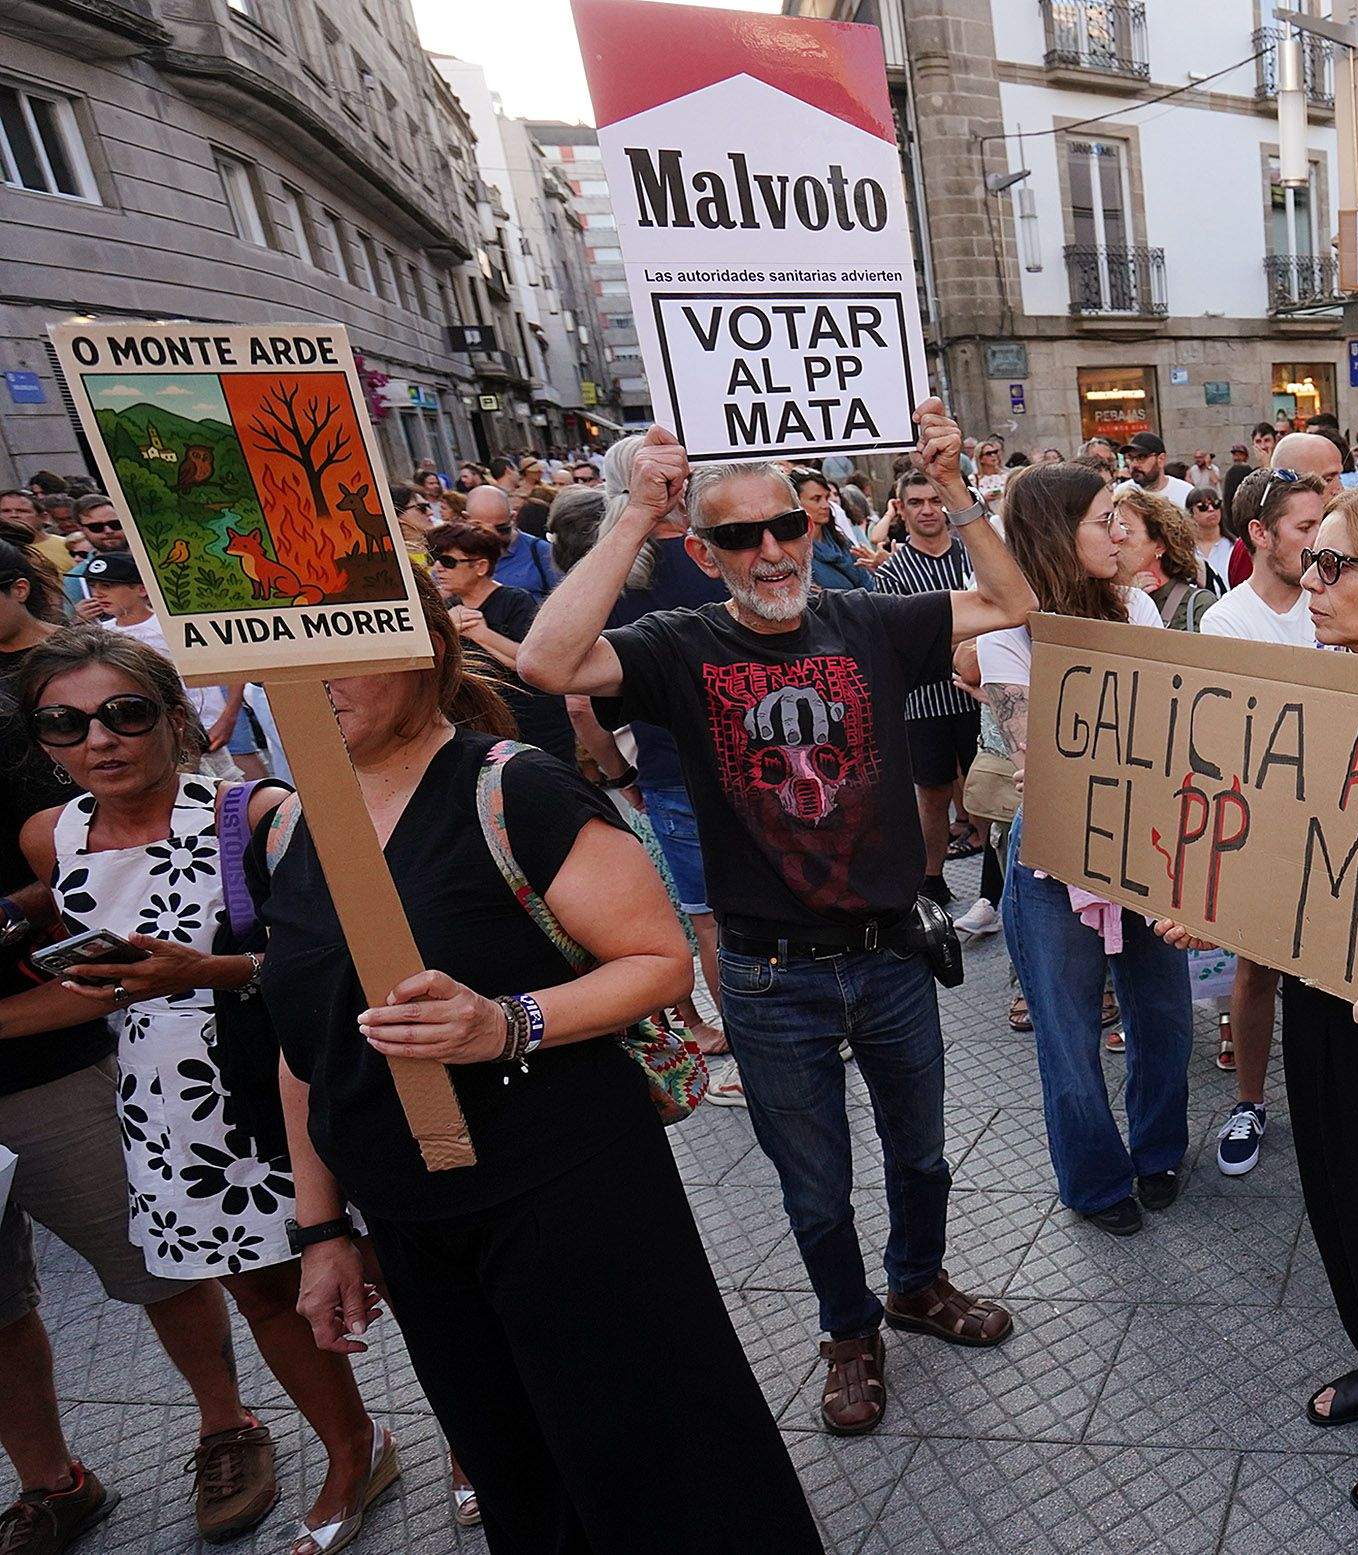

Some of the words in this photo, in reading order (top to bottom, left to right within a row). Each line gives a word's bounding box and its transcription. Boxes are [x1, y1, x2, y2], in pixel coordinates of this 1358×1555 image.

[624, 147, 888, 232] Malvoto
[645, 269, 673, 283] Las
[677, 270, 766, 283] autoridades
[769, 270, 837, 283] sanitarias
[841, 269, 903, 283] advierten
[681, 304, 888, 351] VOTAR
[72, 336, 100, 366] O
[107, 336, 237, 366] MONTE
[250, 336, 339, 366] ARDE
[727, 357, 791, 395] AL
[803, 355, 863, 392] PP
[723, 397, 881, 446] MATA
[185, 622, 208, 648] A
[208, 615, 296, 645] VIDA
[300, 607, 415, 639] MORRE
[1083, 774, 1150, 897] EL
[1173, 783, 1251, 923] PP
